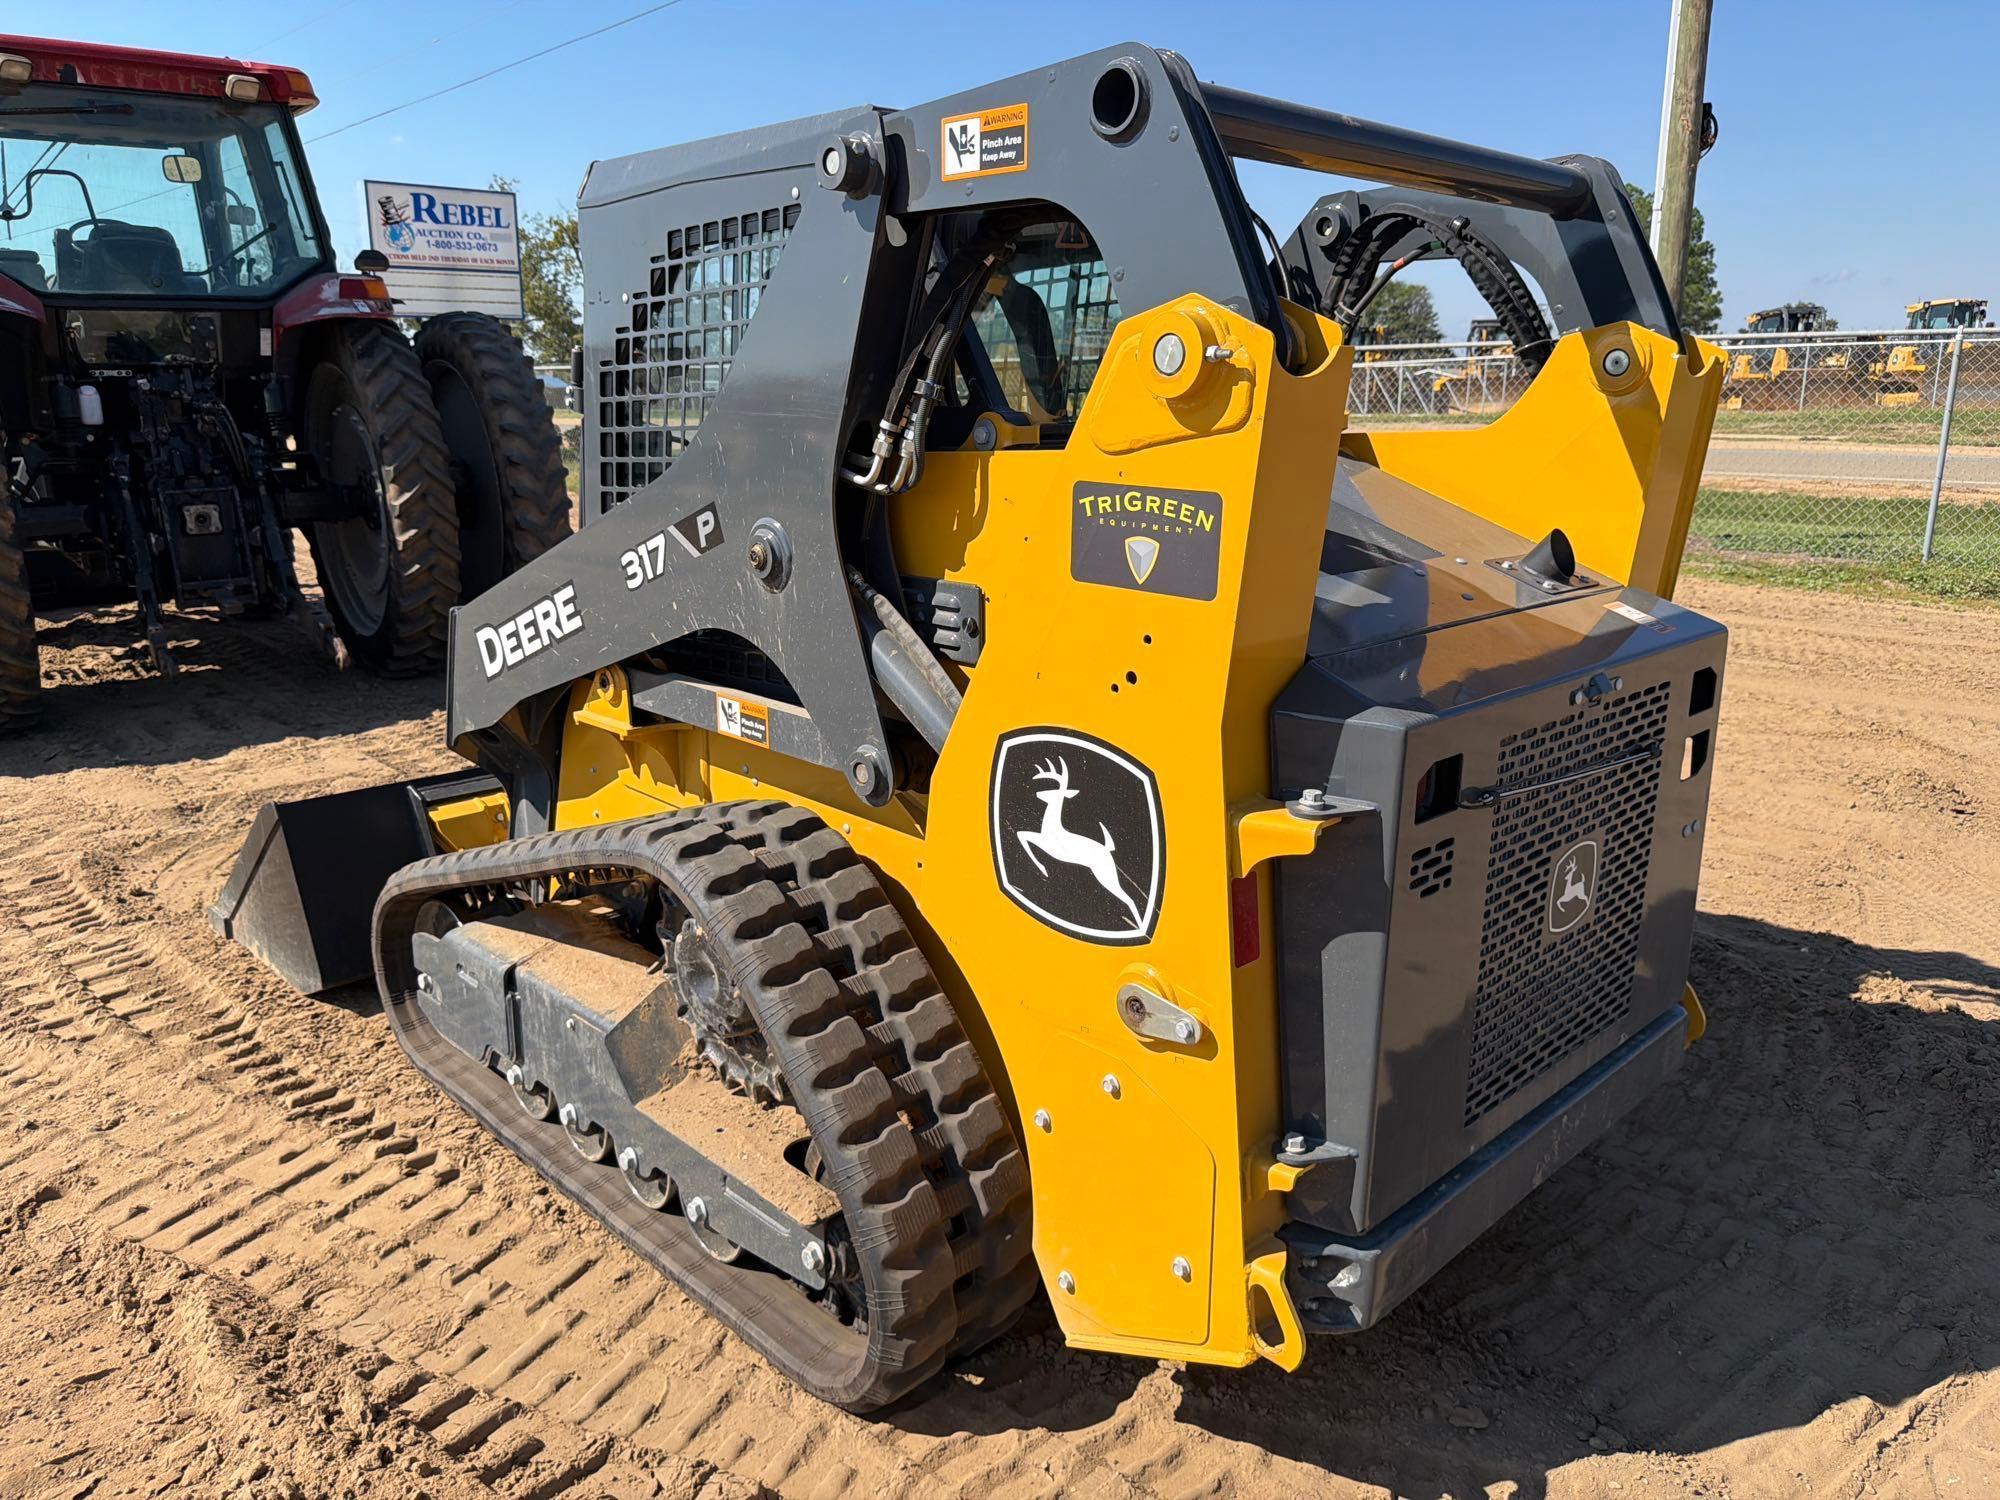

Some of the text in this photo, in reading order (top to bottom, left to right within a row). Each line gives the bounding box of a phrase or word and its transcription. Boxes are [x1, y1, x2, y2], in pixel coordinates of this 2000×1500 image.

[990, 111, 1024, 124] WARNING
[982, 135, 1022, 149] Pinch Area
[982, 150, 1017, 162] Keep Away
[416, 228, 464, 239] AUCTION
[426, 240, 498, 252] 1-800-533-0673
[1100, 518, 1193, 534] EQUIPMENT
[621, 511, 715, 590] 317 P
[475, 585, 583, 678] DEERE
[741, 717, 766, 730] Pinch Area
[752, 731, 763, 739] Away
